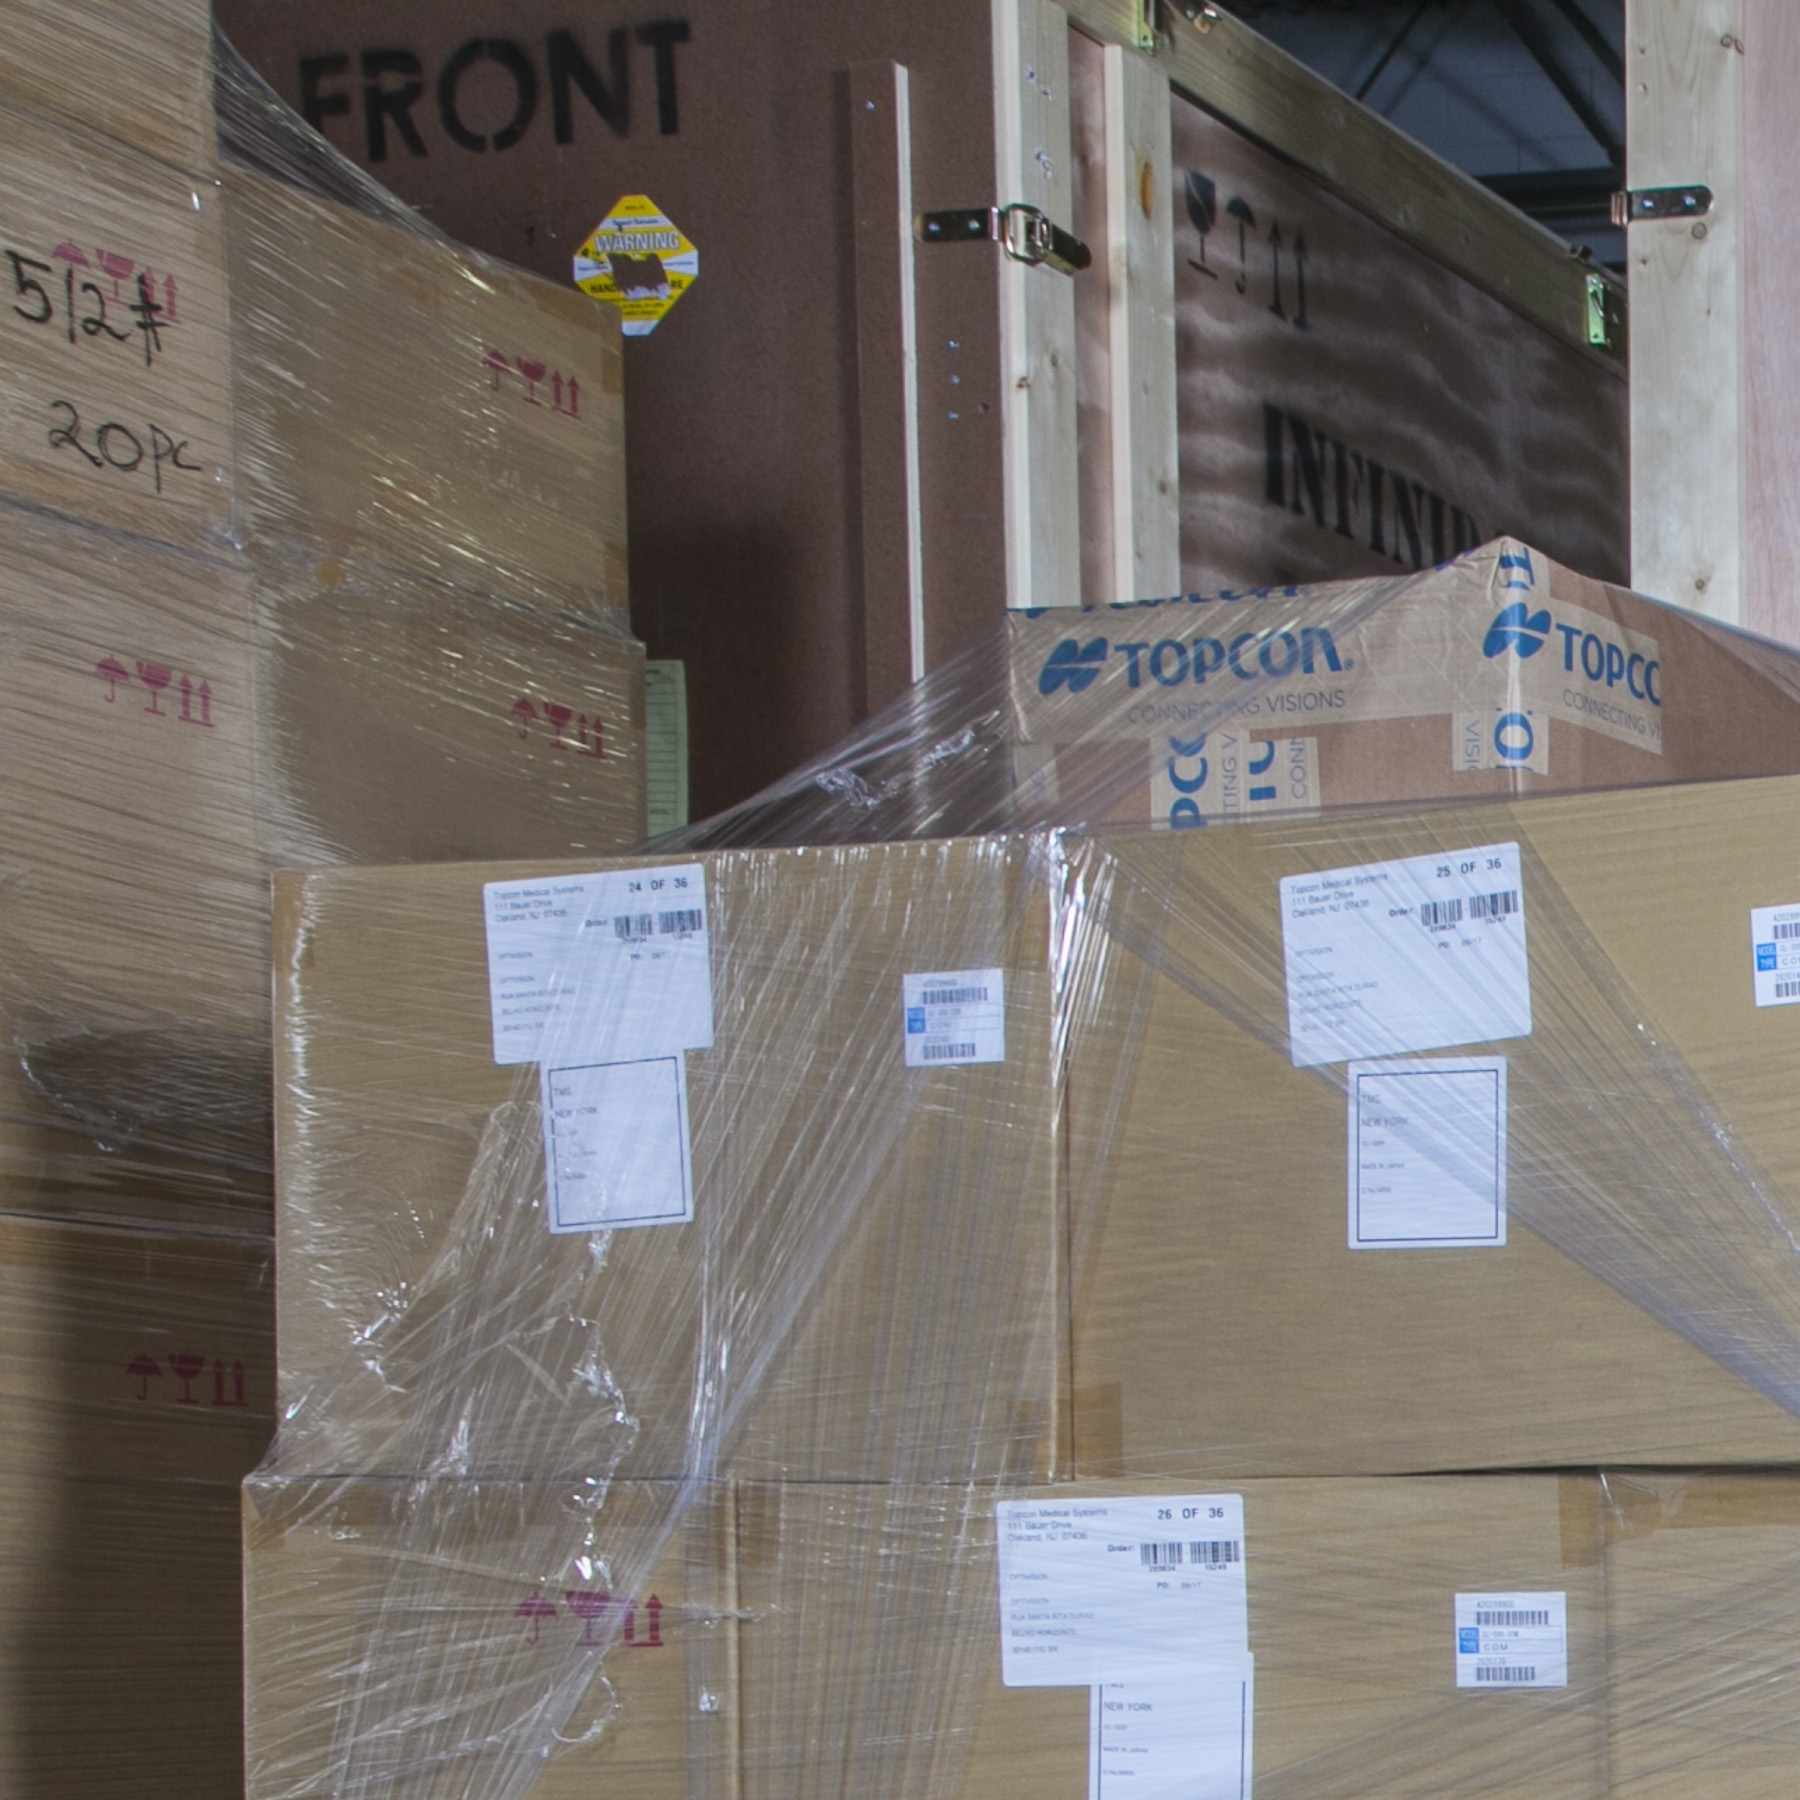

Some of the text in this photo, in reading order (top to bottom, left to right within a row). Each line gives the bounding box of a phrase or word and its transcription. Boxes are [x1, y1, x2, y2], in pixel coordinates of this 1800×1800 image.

[300, 20, 690, 162] FRONT
[594, 231, 681, 252] WARNING
[1266, 690, 1345, 712] VISIONS
[1563, 689, 1646, 735] CONNECTING
[1322, 879, 1351, 889] Medical
[1437, 867, 1451, 877] 25
[1461, 862, 1476, 874] OF
[1487, 859, 1502, 870] 36
[629, 883, 641, 892] 24
[651, 880, 665, 890] OF
[674, 879, 687, 888] 36
[1308, 894, 1331, 904] Bauer
[1040, 1509, 1070, 1518] Medical
[1073, 1508, 1107, 1518] Systems
[1158, 1510, 1172, 1520] 26
[1183, 1508, 1198, 1519] OF
[1209, 1508, 1224, 1519] 36
[1025, 1521, 1049, 1529] Bauer
[1104, 1702, 1152, 1712] NEW YORK
